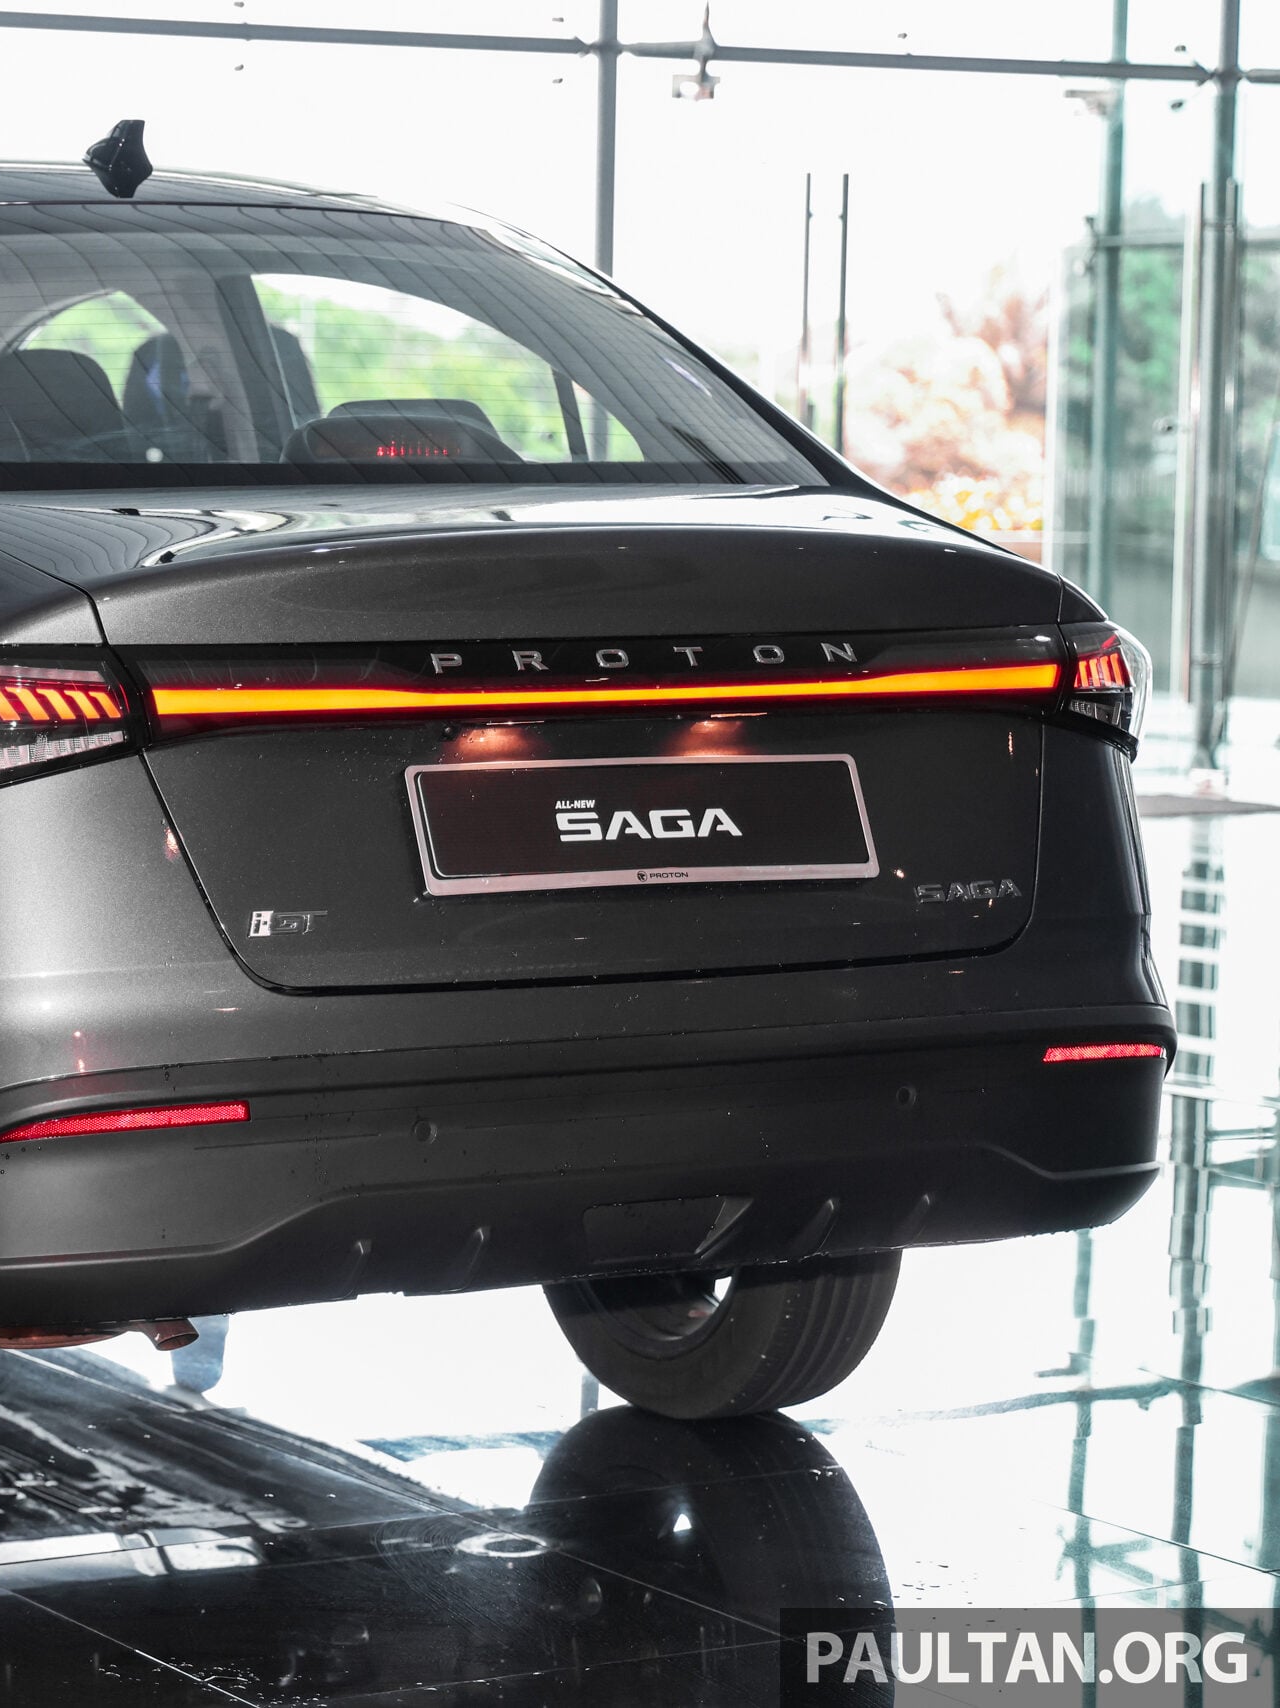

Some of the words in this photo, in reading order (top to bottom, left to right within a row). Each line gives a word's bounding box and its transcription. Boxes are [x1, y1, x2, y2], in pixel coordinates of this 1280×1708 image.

[430, 642, 859, 674] PROTON
[555, 799, 596, 809] ALL-NEW
[556, 808, 742, 841] SAGA
[649, 871, 689, 880] PROTON
[914, 878, 1022, 903] SAGA
